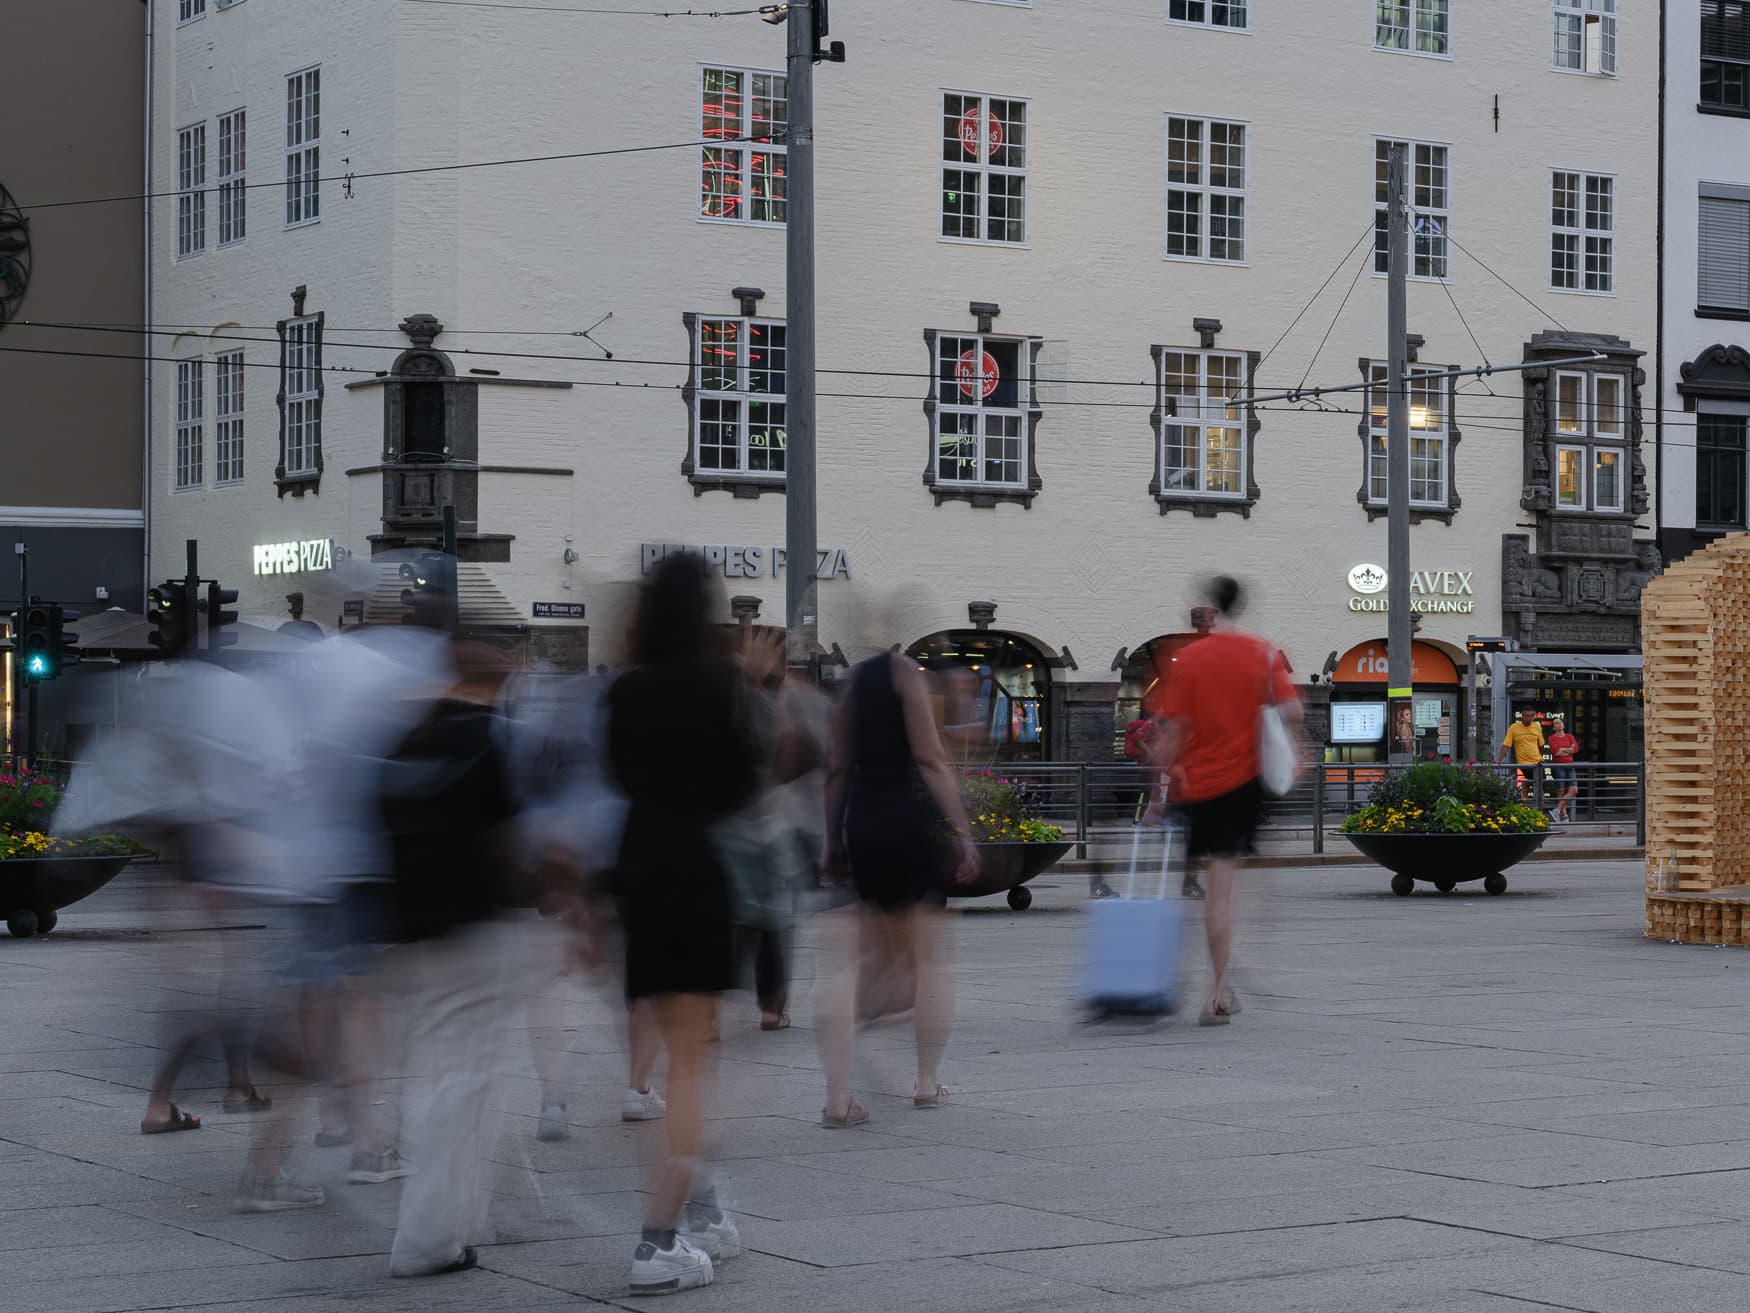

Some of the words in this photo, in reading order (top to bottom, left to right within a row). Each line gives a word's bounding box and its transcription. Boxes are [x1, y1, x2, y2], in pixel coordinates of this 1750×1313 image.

[253, 542, 299, 575] PEPPES
[300, 538, 332, 572] PIZZA
[773, 547, 850, 579] PZA
[1409, 571, 1473, 595] AVEX
